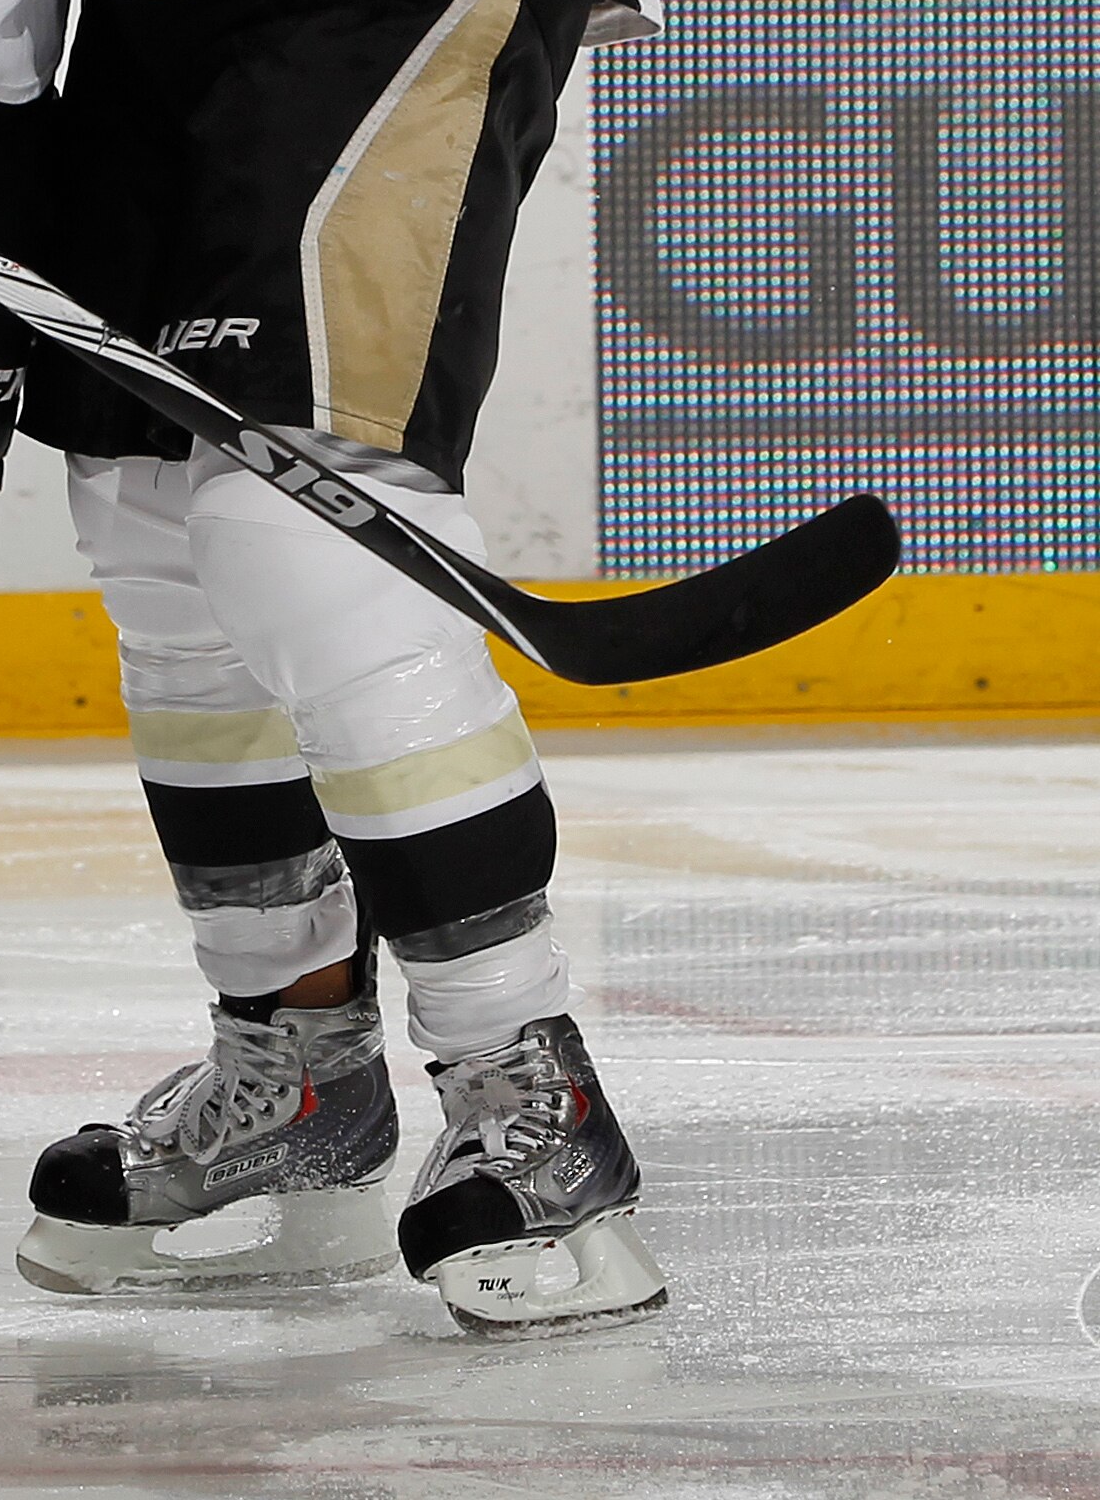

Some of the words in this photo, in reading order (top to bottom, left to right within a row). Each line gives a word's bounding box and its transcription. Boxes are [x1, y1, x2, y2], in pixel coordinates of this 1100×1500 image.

[152, 317, 260, 356] UER
[220, 429, 378, 528] S19
[211, 1150, 283, 1183] BAUER
